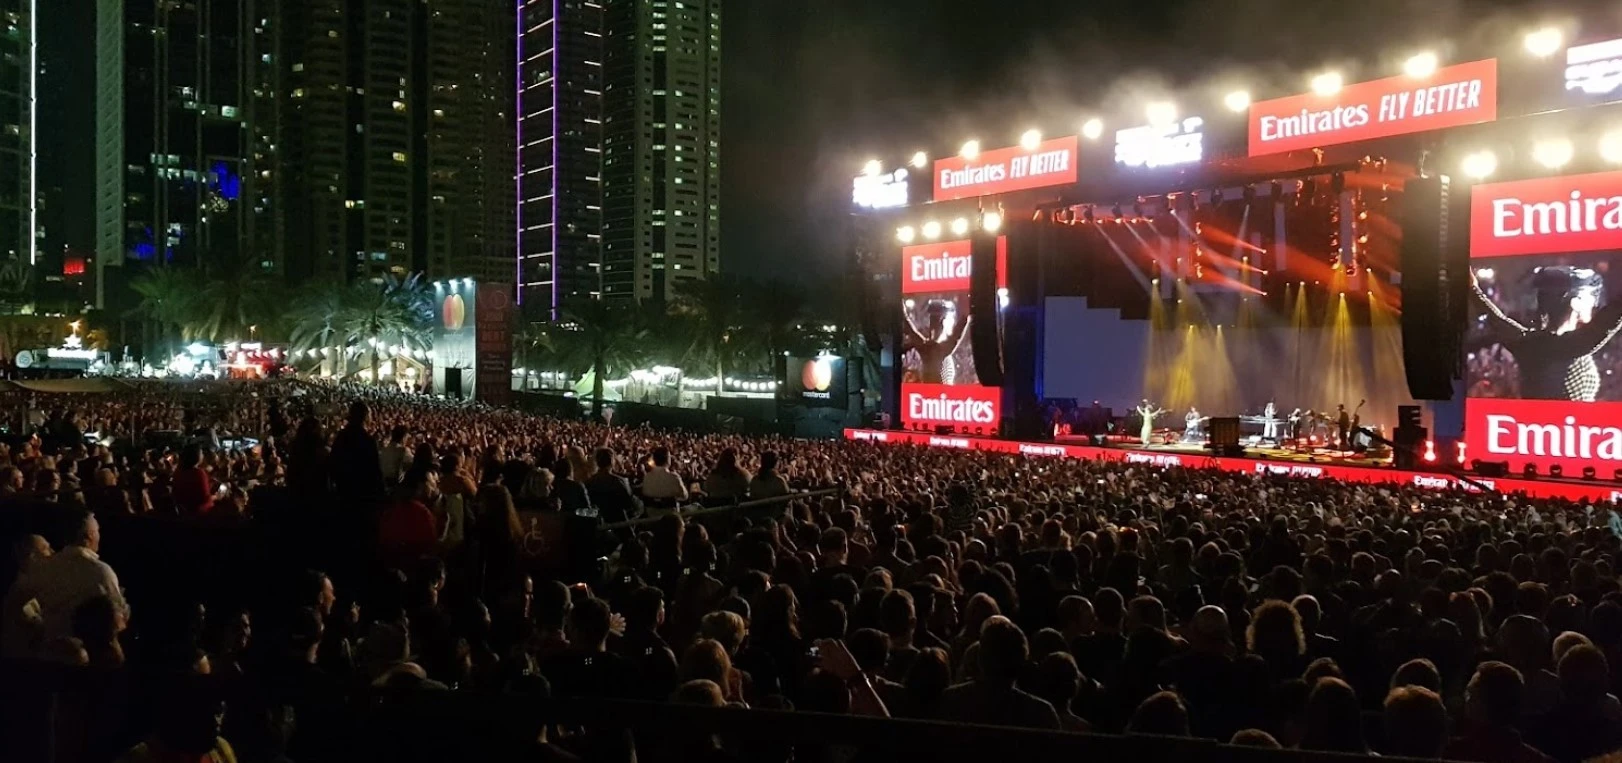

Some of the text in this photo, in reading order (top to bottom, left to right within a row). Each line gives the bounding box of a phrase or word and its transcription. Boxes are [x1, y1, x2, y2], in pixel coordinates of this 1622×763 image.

[1260, 79, 1481, 141] Emirates FLY BETTER
[940, 149, 1070, 189] Emirates FLY BETTER
[1493, 190, 1622, 238] Emira
[909, 393, 994, 423] Emirates
[1486, 415, 1622, 461] Emira
